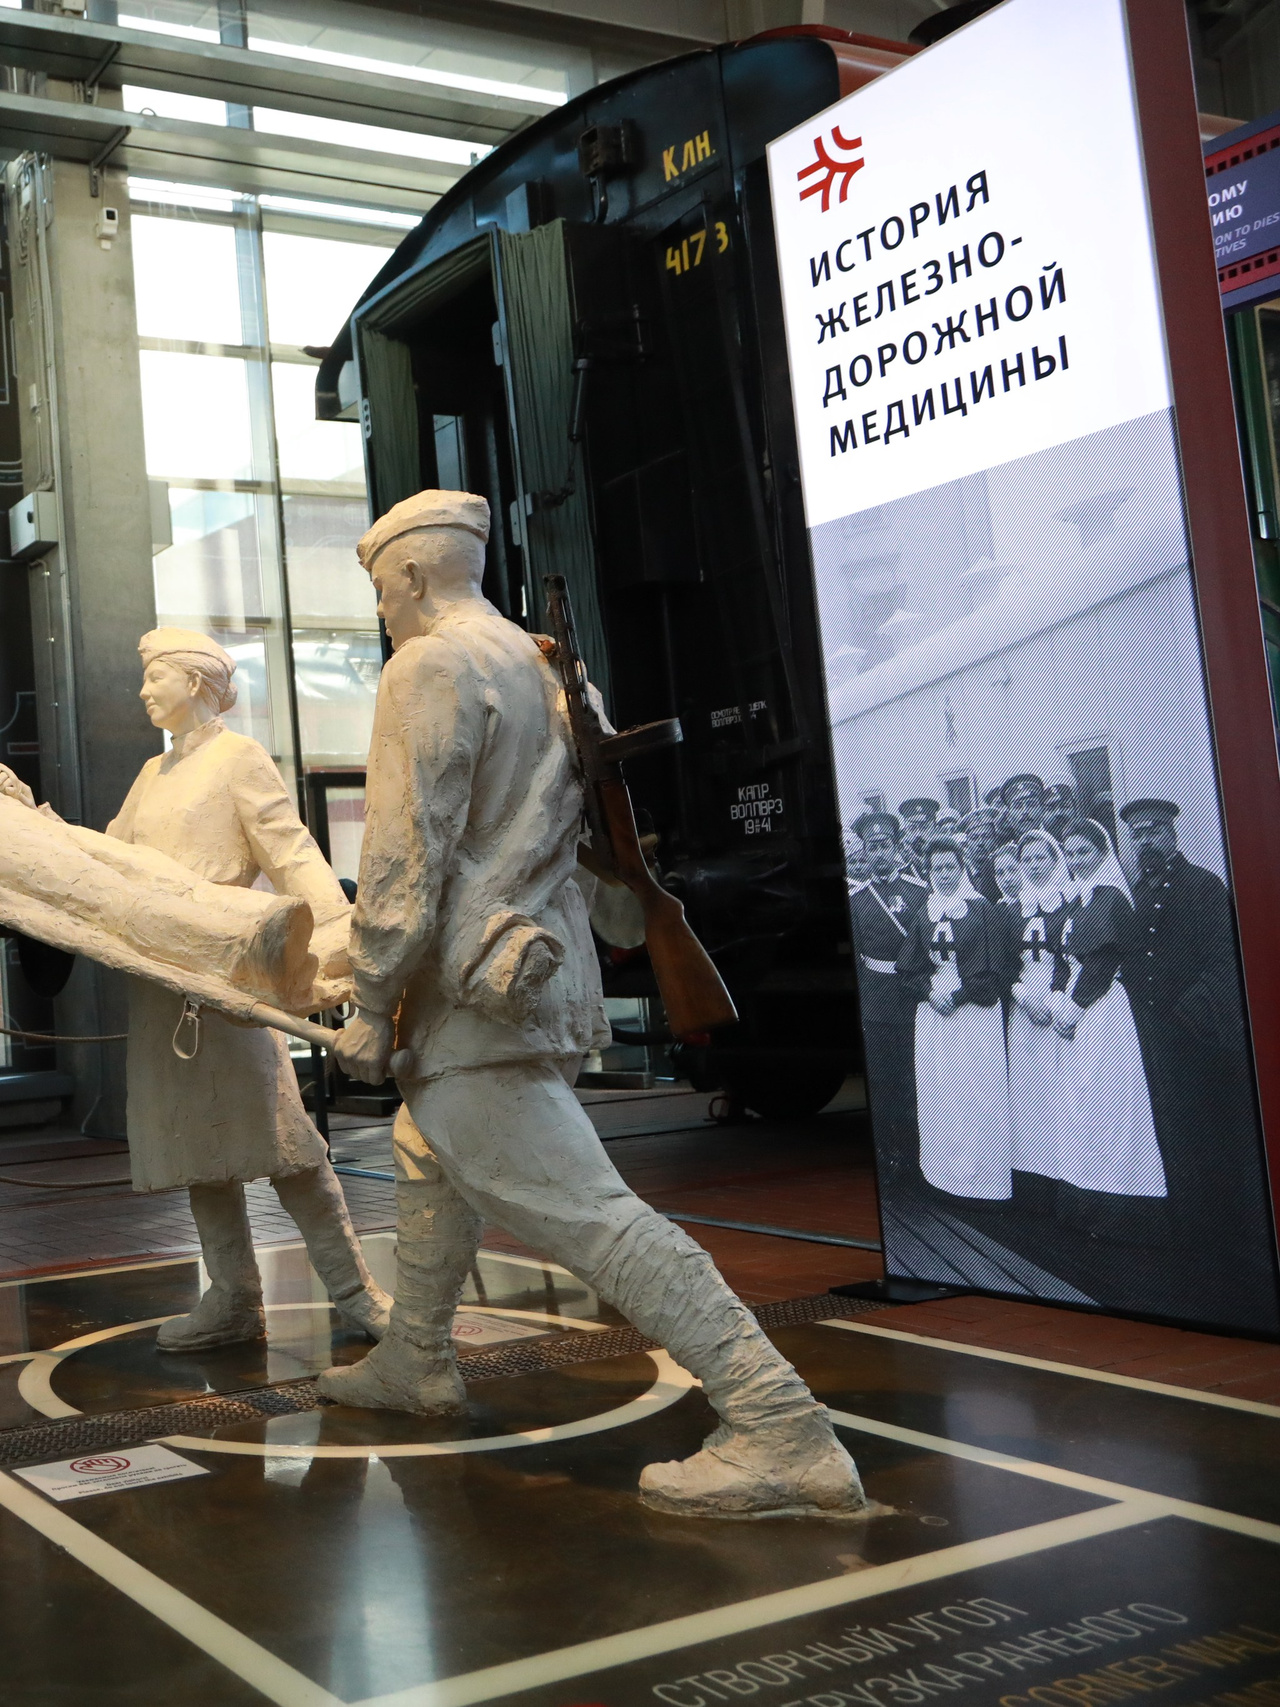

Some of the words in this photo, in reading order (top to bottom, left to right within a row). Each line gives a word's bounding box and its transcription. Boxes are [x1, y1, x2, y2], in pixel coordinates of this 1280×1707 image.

[809, 169, 990, 288] ИСТОРИЯ
[1235, 224, 1251, 238] TO
[815, 231, 1023, 345] ЖЕЛЕЗНО-
[822, 261, 1067, 408] ДОРОЖНОЙ
[829, 335, 1070, 457] МЕДИЦИНЫ
[652, 1624, 916, 1707] СТВОРНЫЙ
[887, 1597, 1029, 1641] УГОЛ
[781, 1663, 985, 1707] РУЗКА
[953, 1602, 1189, 1677] РАНЕНОГО
